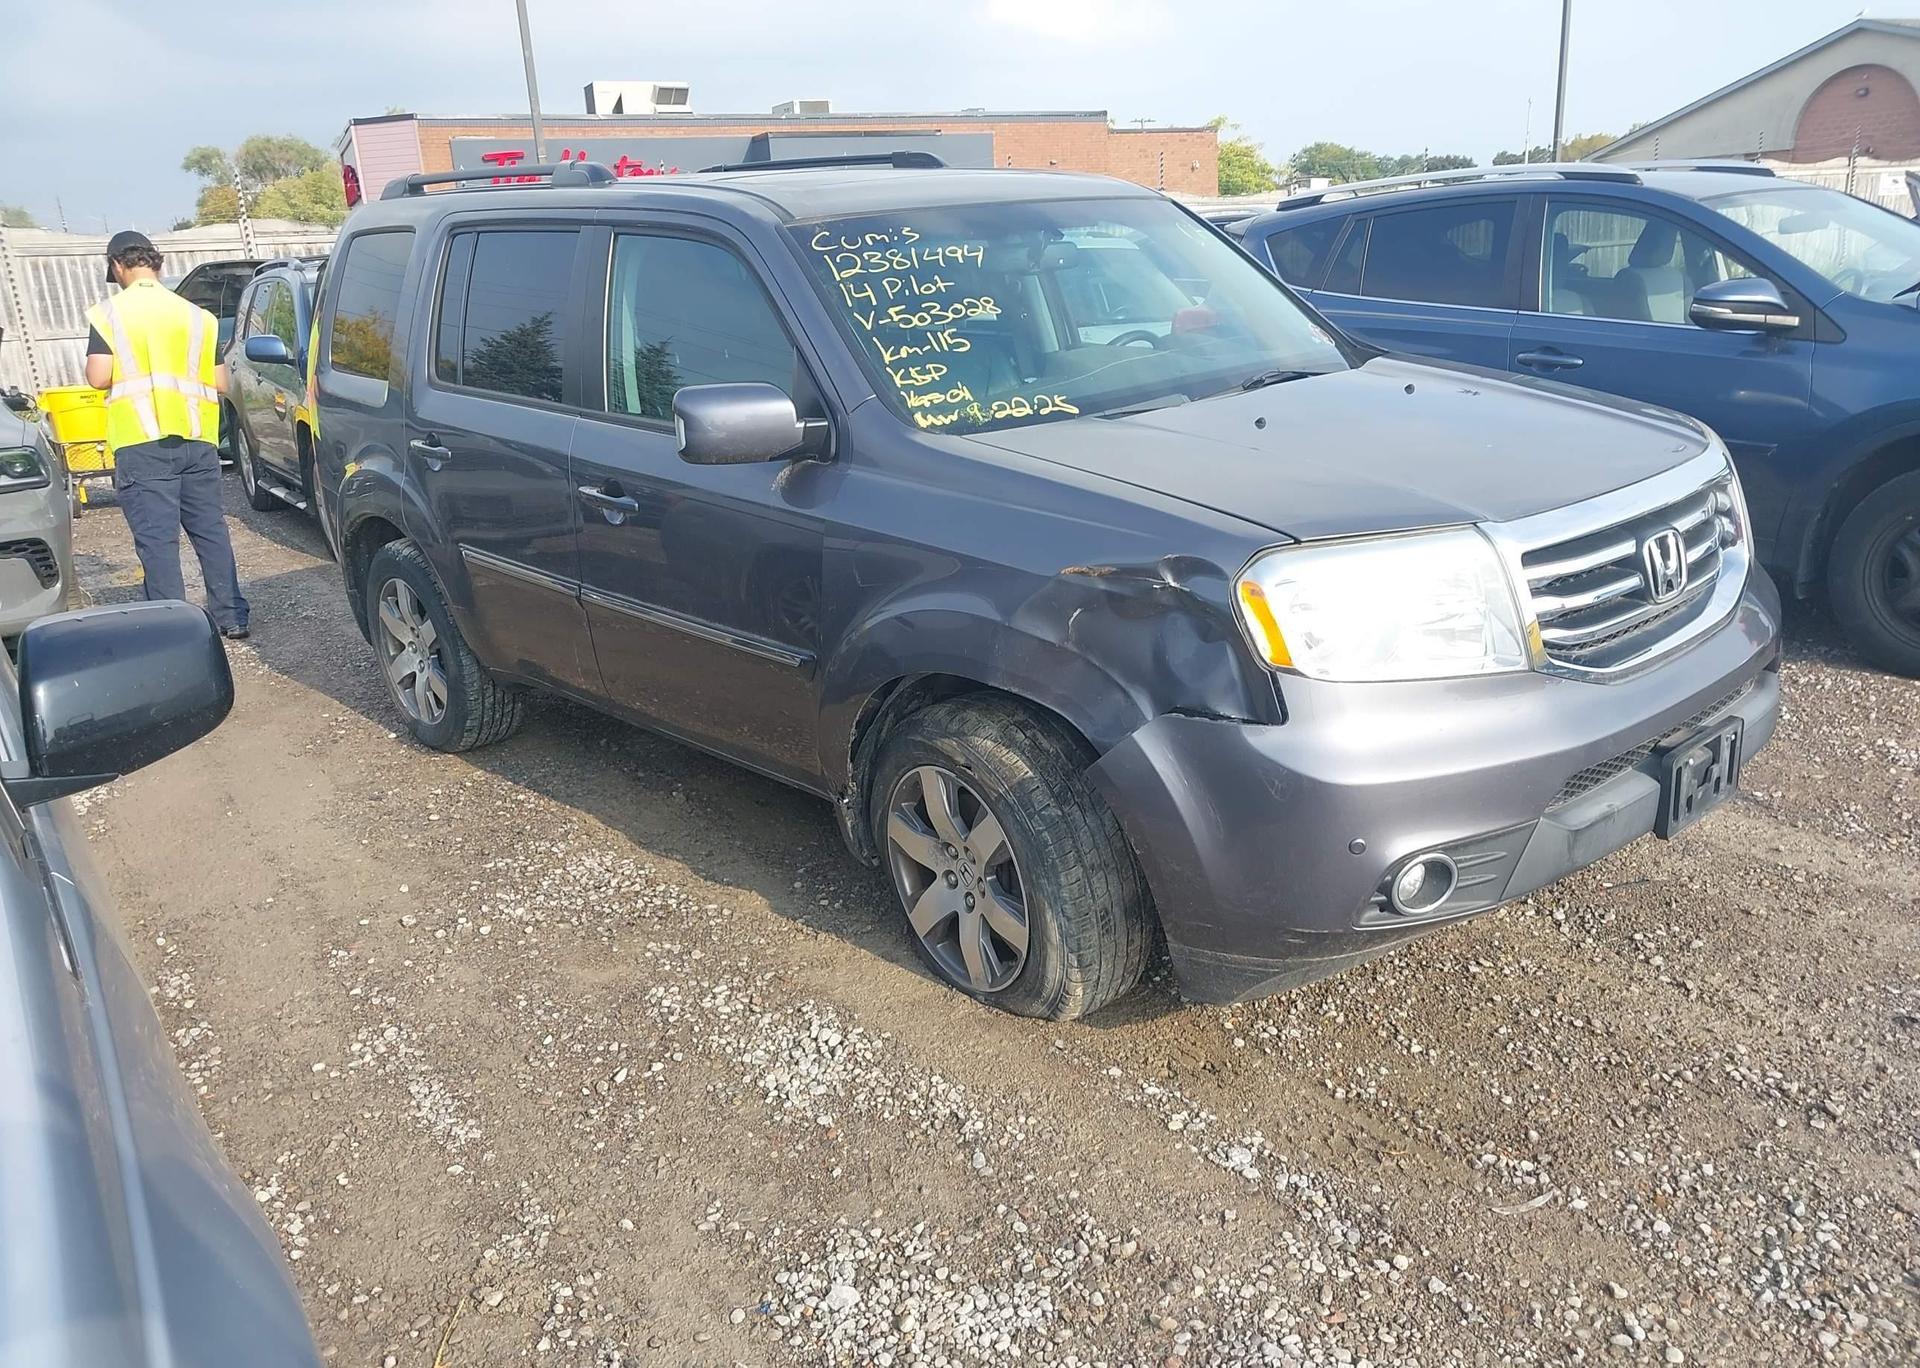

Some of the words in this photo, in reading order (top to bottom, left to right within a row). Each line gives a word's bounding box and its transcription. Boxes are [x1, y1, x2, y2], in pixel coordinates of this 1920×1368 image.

[823, 244, 984, 281] 12381494
[839, 282, 877, 307] 14
[882, 274, 955, 299] Pilot
[853, 296, 1002, 331] V-503028
